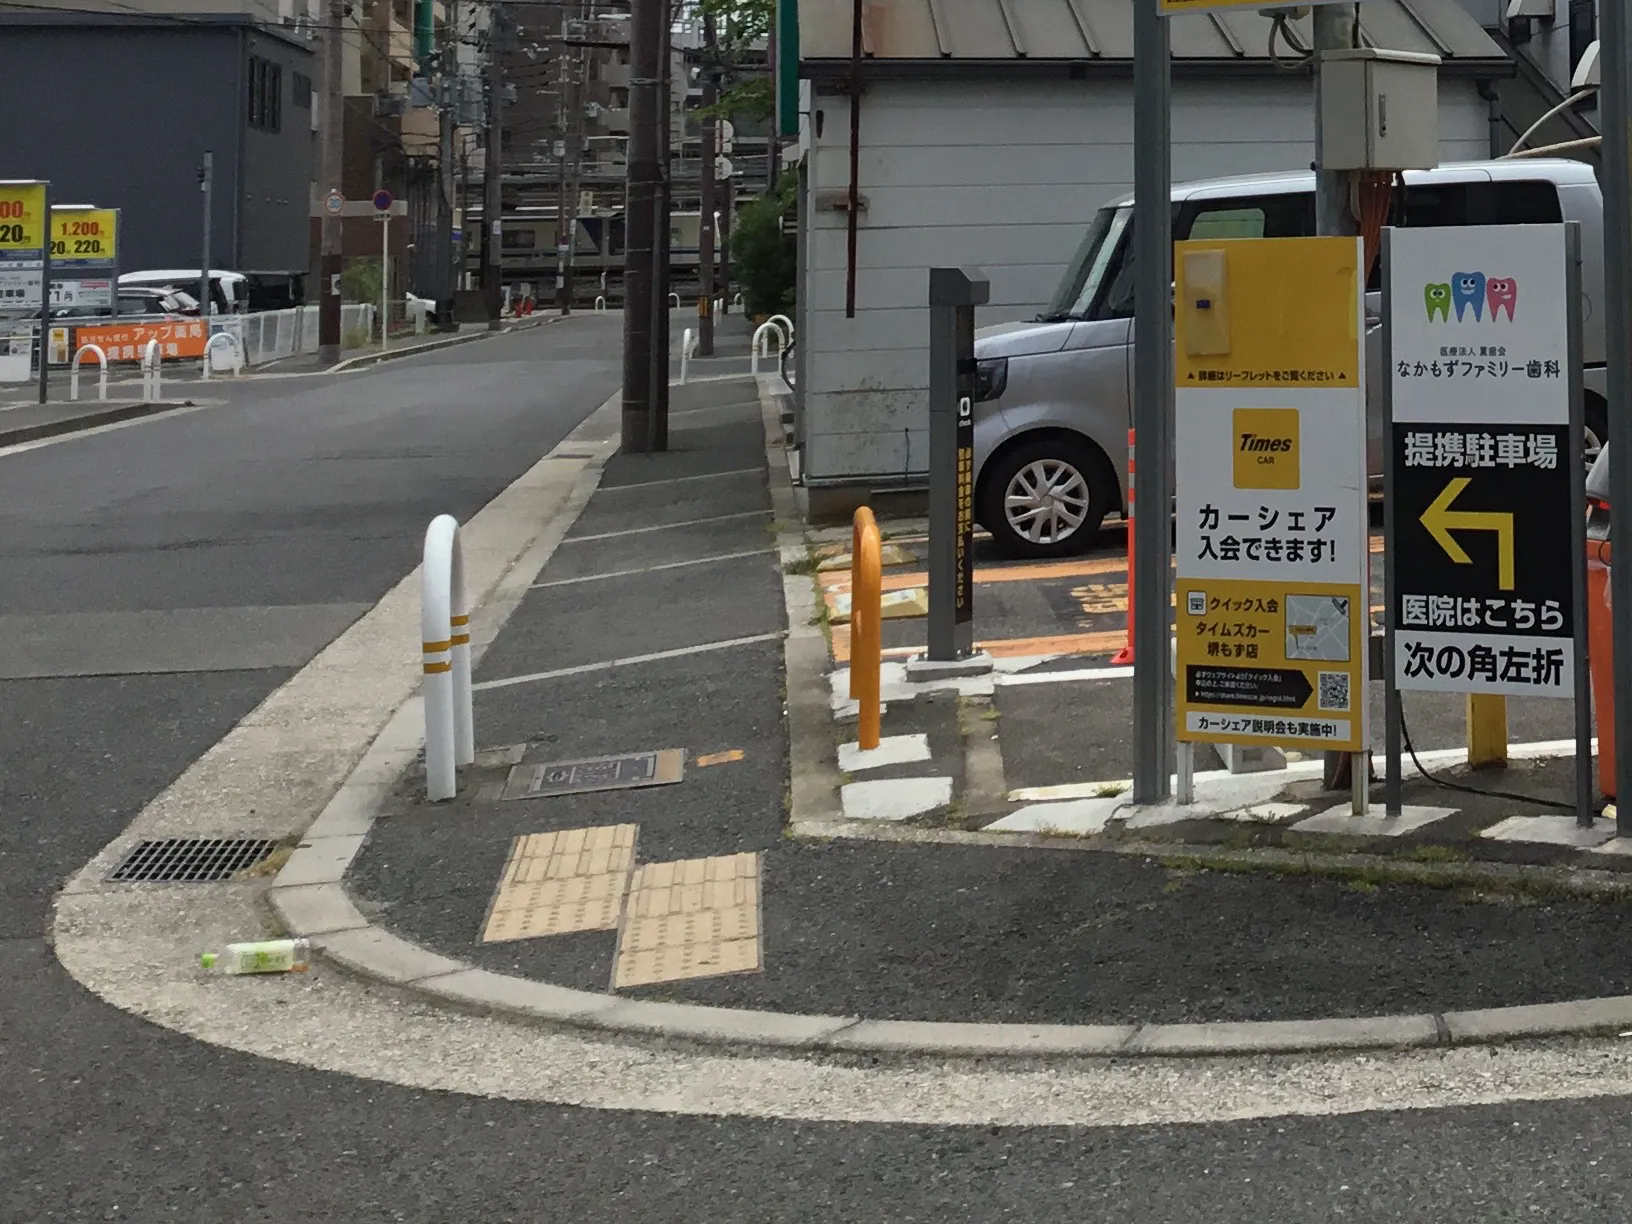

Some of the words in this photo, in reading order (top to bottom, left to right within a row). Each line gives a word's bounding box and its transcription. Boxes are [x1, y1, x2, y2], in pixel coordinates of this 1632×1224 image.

[1198, 370, 1335, 382] 詳細はリーフレットをご覧ください
[1398, 359, 1561, 379] なかもずファミリー歯科
[1240, 433, 1293, 453] Times
[1404, 432, 1558, 470] 提携駐車場
[1256, 456, 1275, 465] CAR
[1198, 504, 1337, 532] カーシェア
[1197, 534, 1337, 564] 入会できます!
[1209, 597, 1280, 614] クイック入会
[1402, 594, 1565, 631] 医院はこちら
[1195, 621, 1271, 638] タイムズカー
[1207, 641, 1259, 659] 堺もず店
[1403, 642, 1565, 687] 次の角左折
[1198, 717, 1338, 738] カーシェア説明会も実施中!
